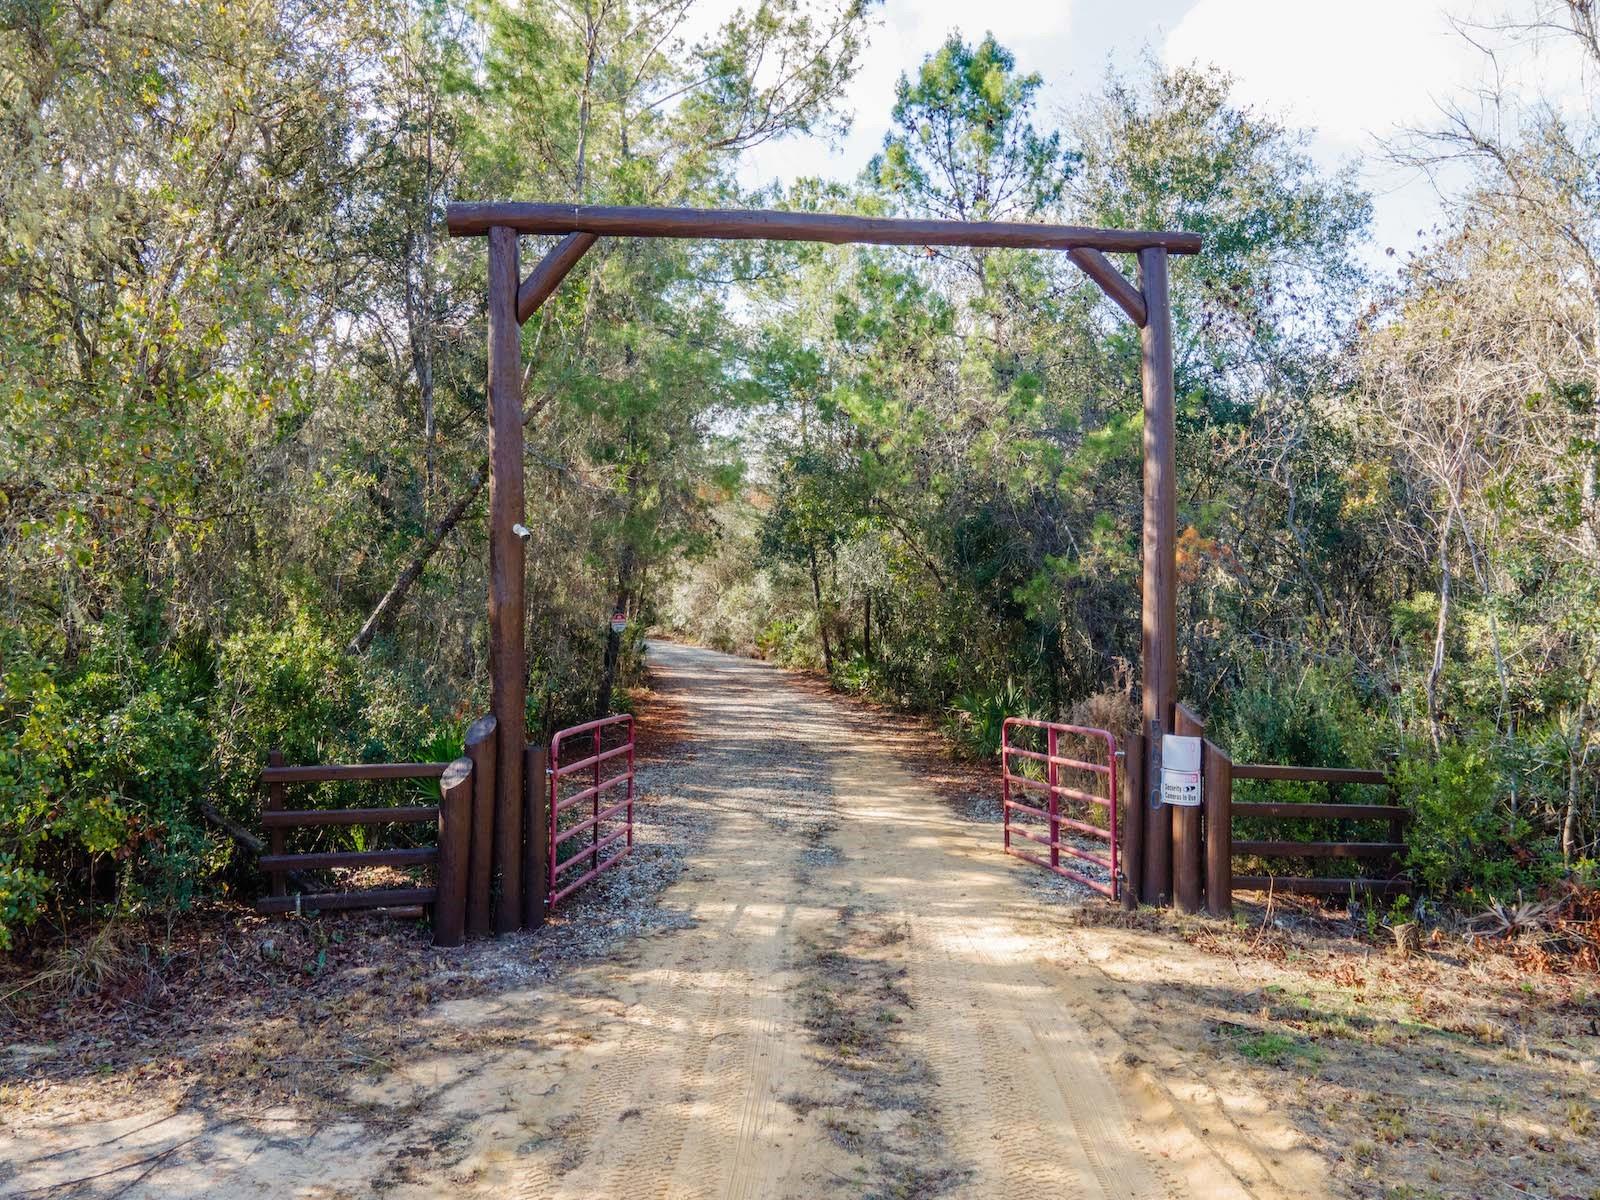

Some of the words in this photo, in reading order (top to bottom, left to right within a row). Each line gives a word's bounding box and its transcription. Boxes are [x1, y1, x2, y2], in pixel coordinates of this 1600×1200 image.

[1165, 783, 1182, 793] Security
[1165, 791, 1182, 801] Cameras
[1188, 793, 1197, 802] Use
